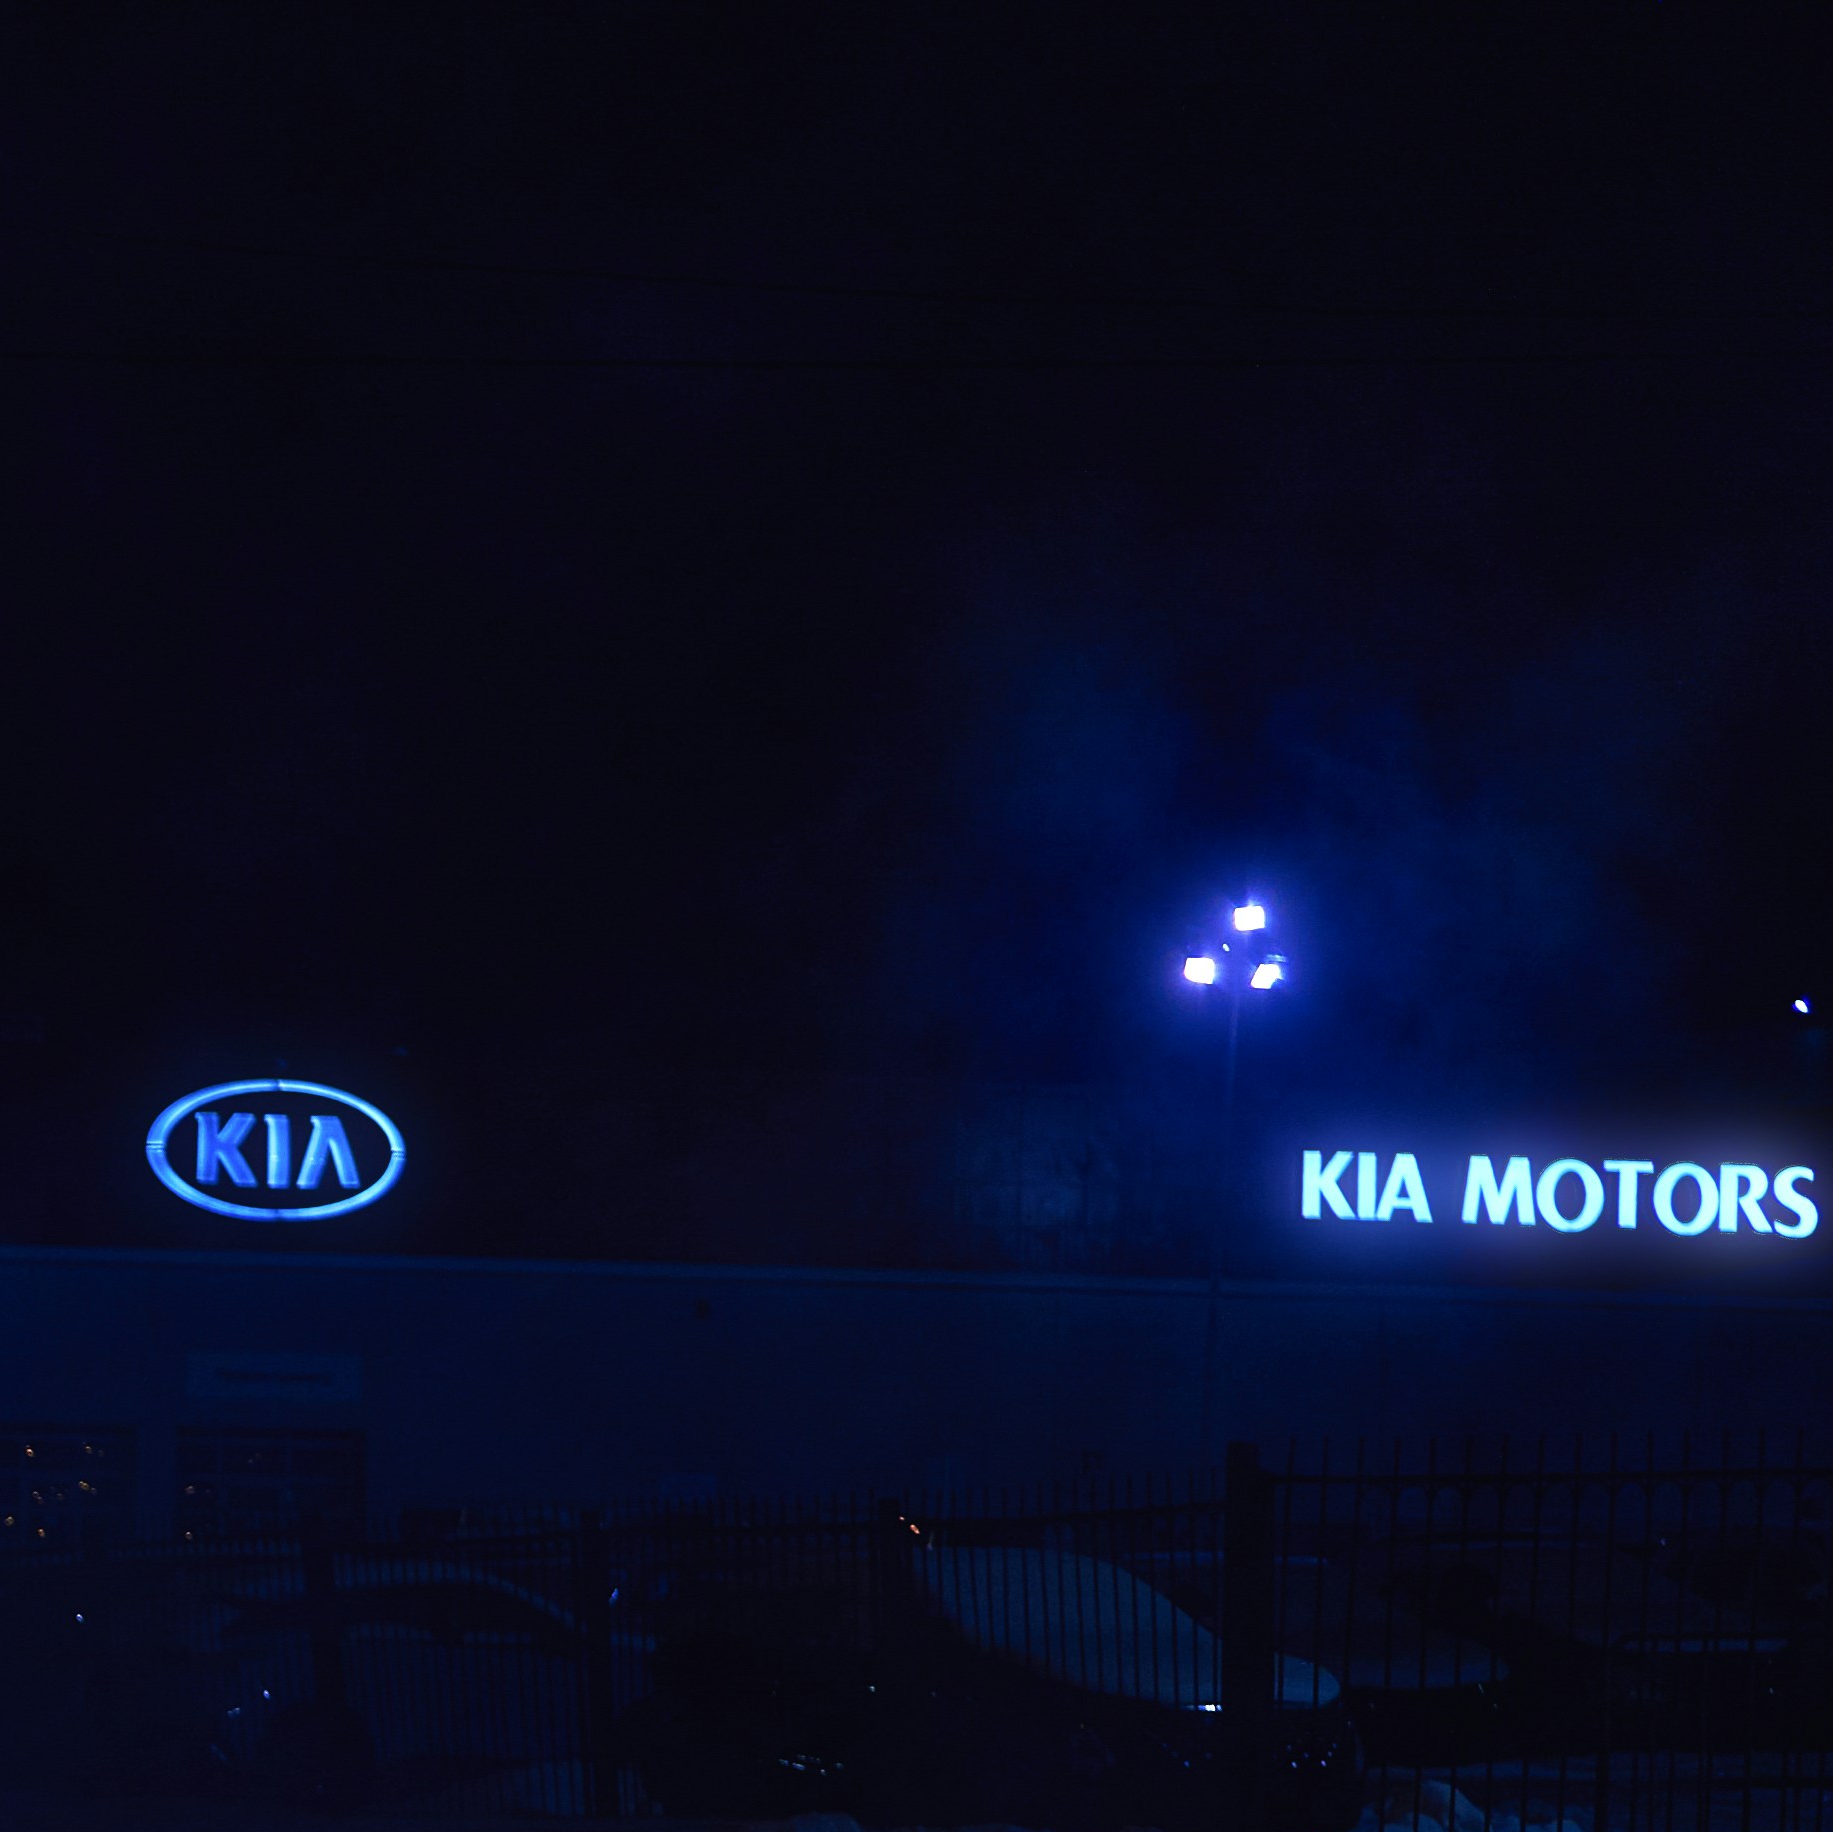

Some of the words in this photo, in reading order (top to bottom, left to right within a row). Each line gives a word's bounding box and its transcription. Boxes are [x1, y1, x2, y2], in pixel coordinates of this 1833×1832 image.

[194, 1111, 361, 1188] KIA
[1301, 1150, 1434, 1224] KIA
[1461, 1154, 1820, 1240] MOTORS
